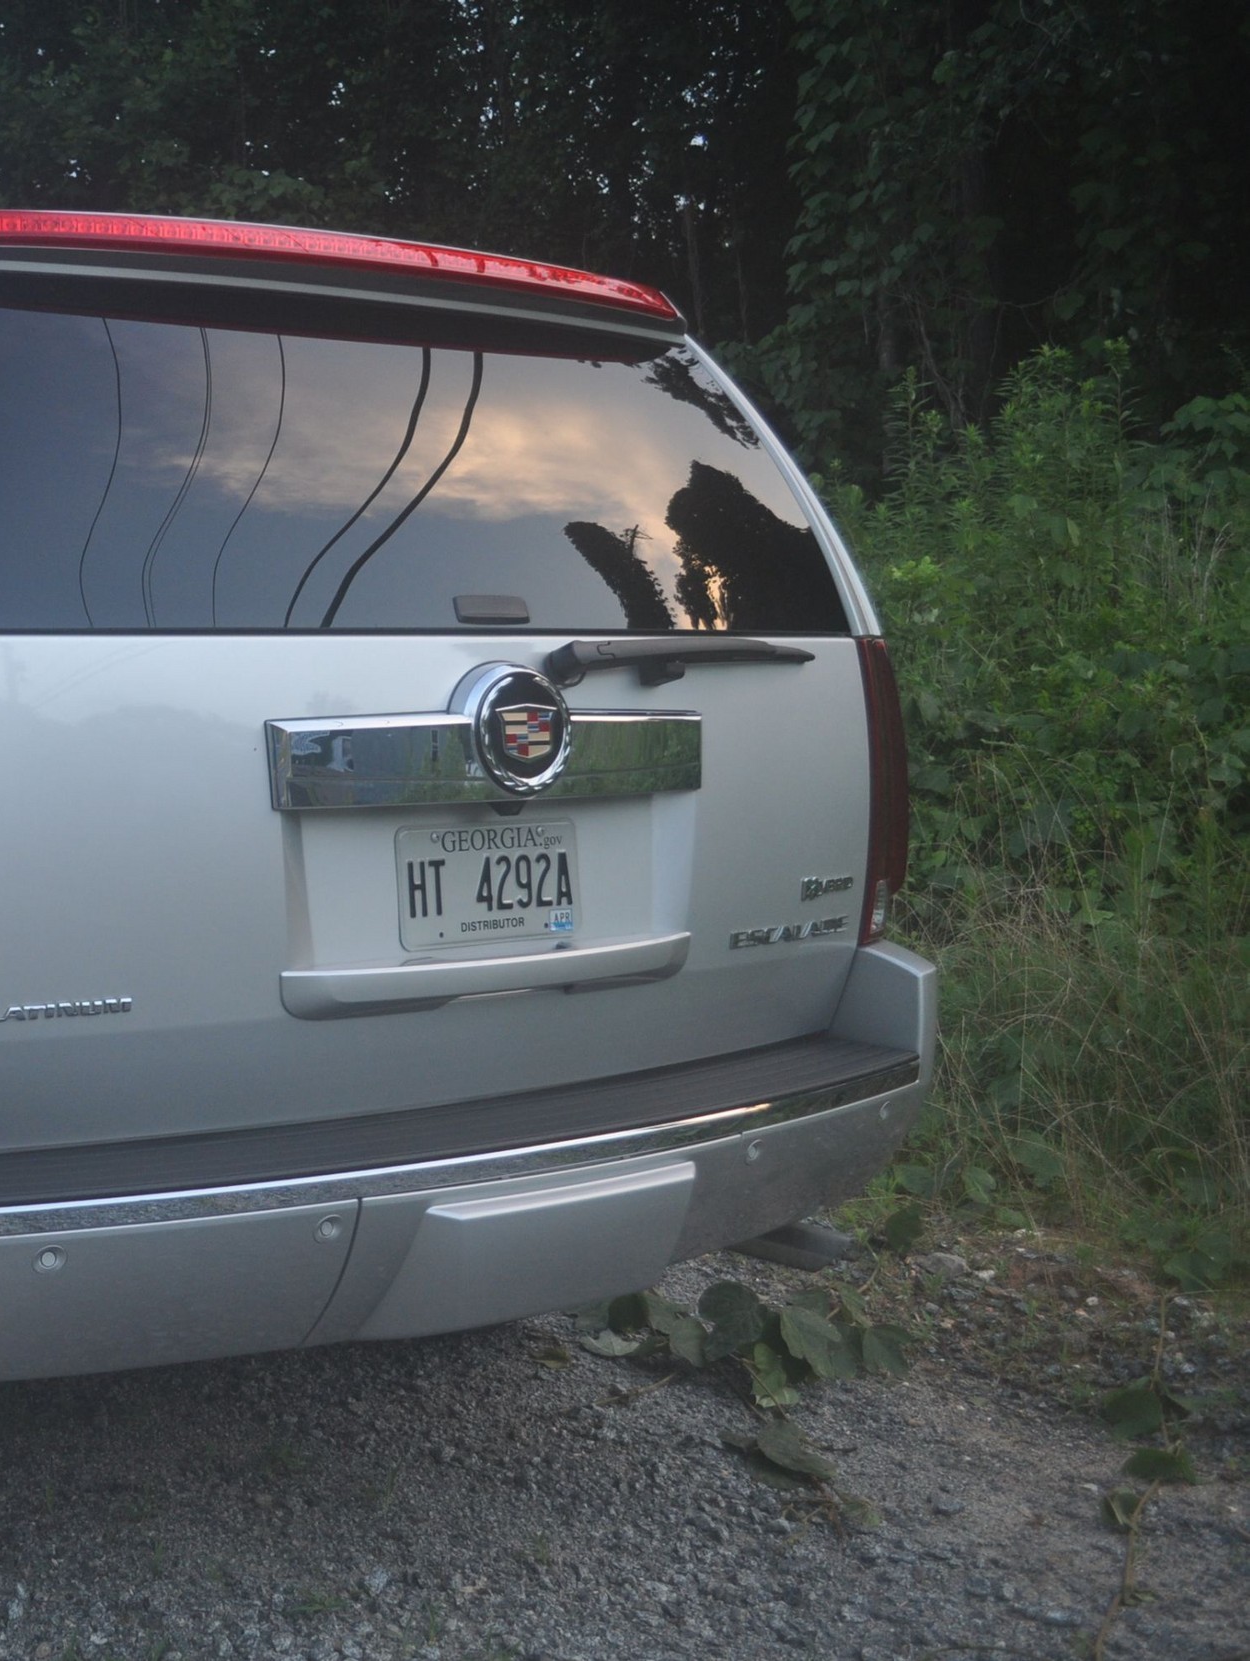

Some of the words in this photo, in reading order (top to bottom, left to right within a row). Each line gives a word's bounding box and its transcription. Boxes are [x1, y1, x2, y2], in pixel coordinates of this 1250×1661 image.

[407, 858, 446, 919] HT
[476, 851, 573, 912] 4292A
[461, 916, 525, 933] DISTRIBUTOR
